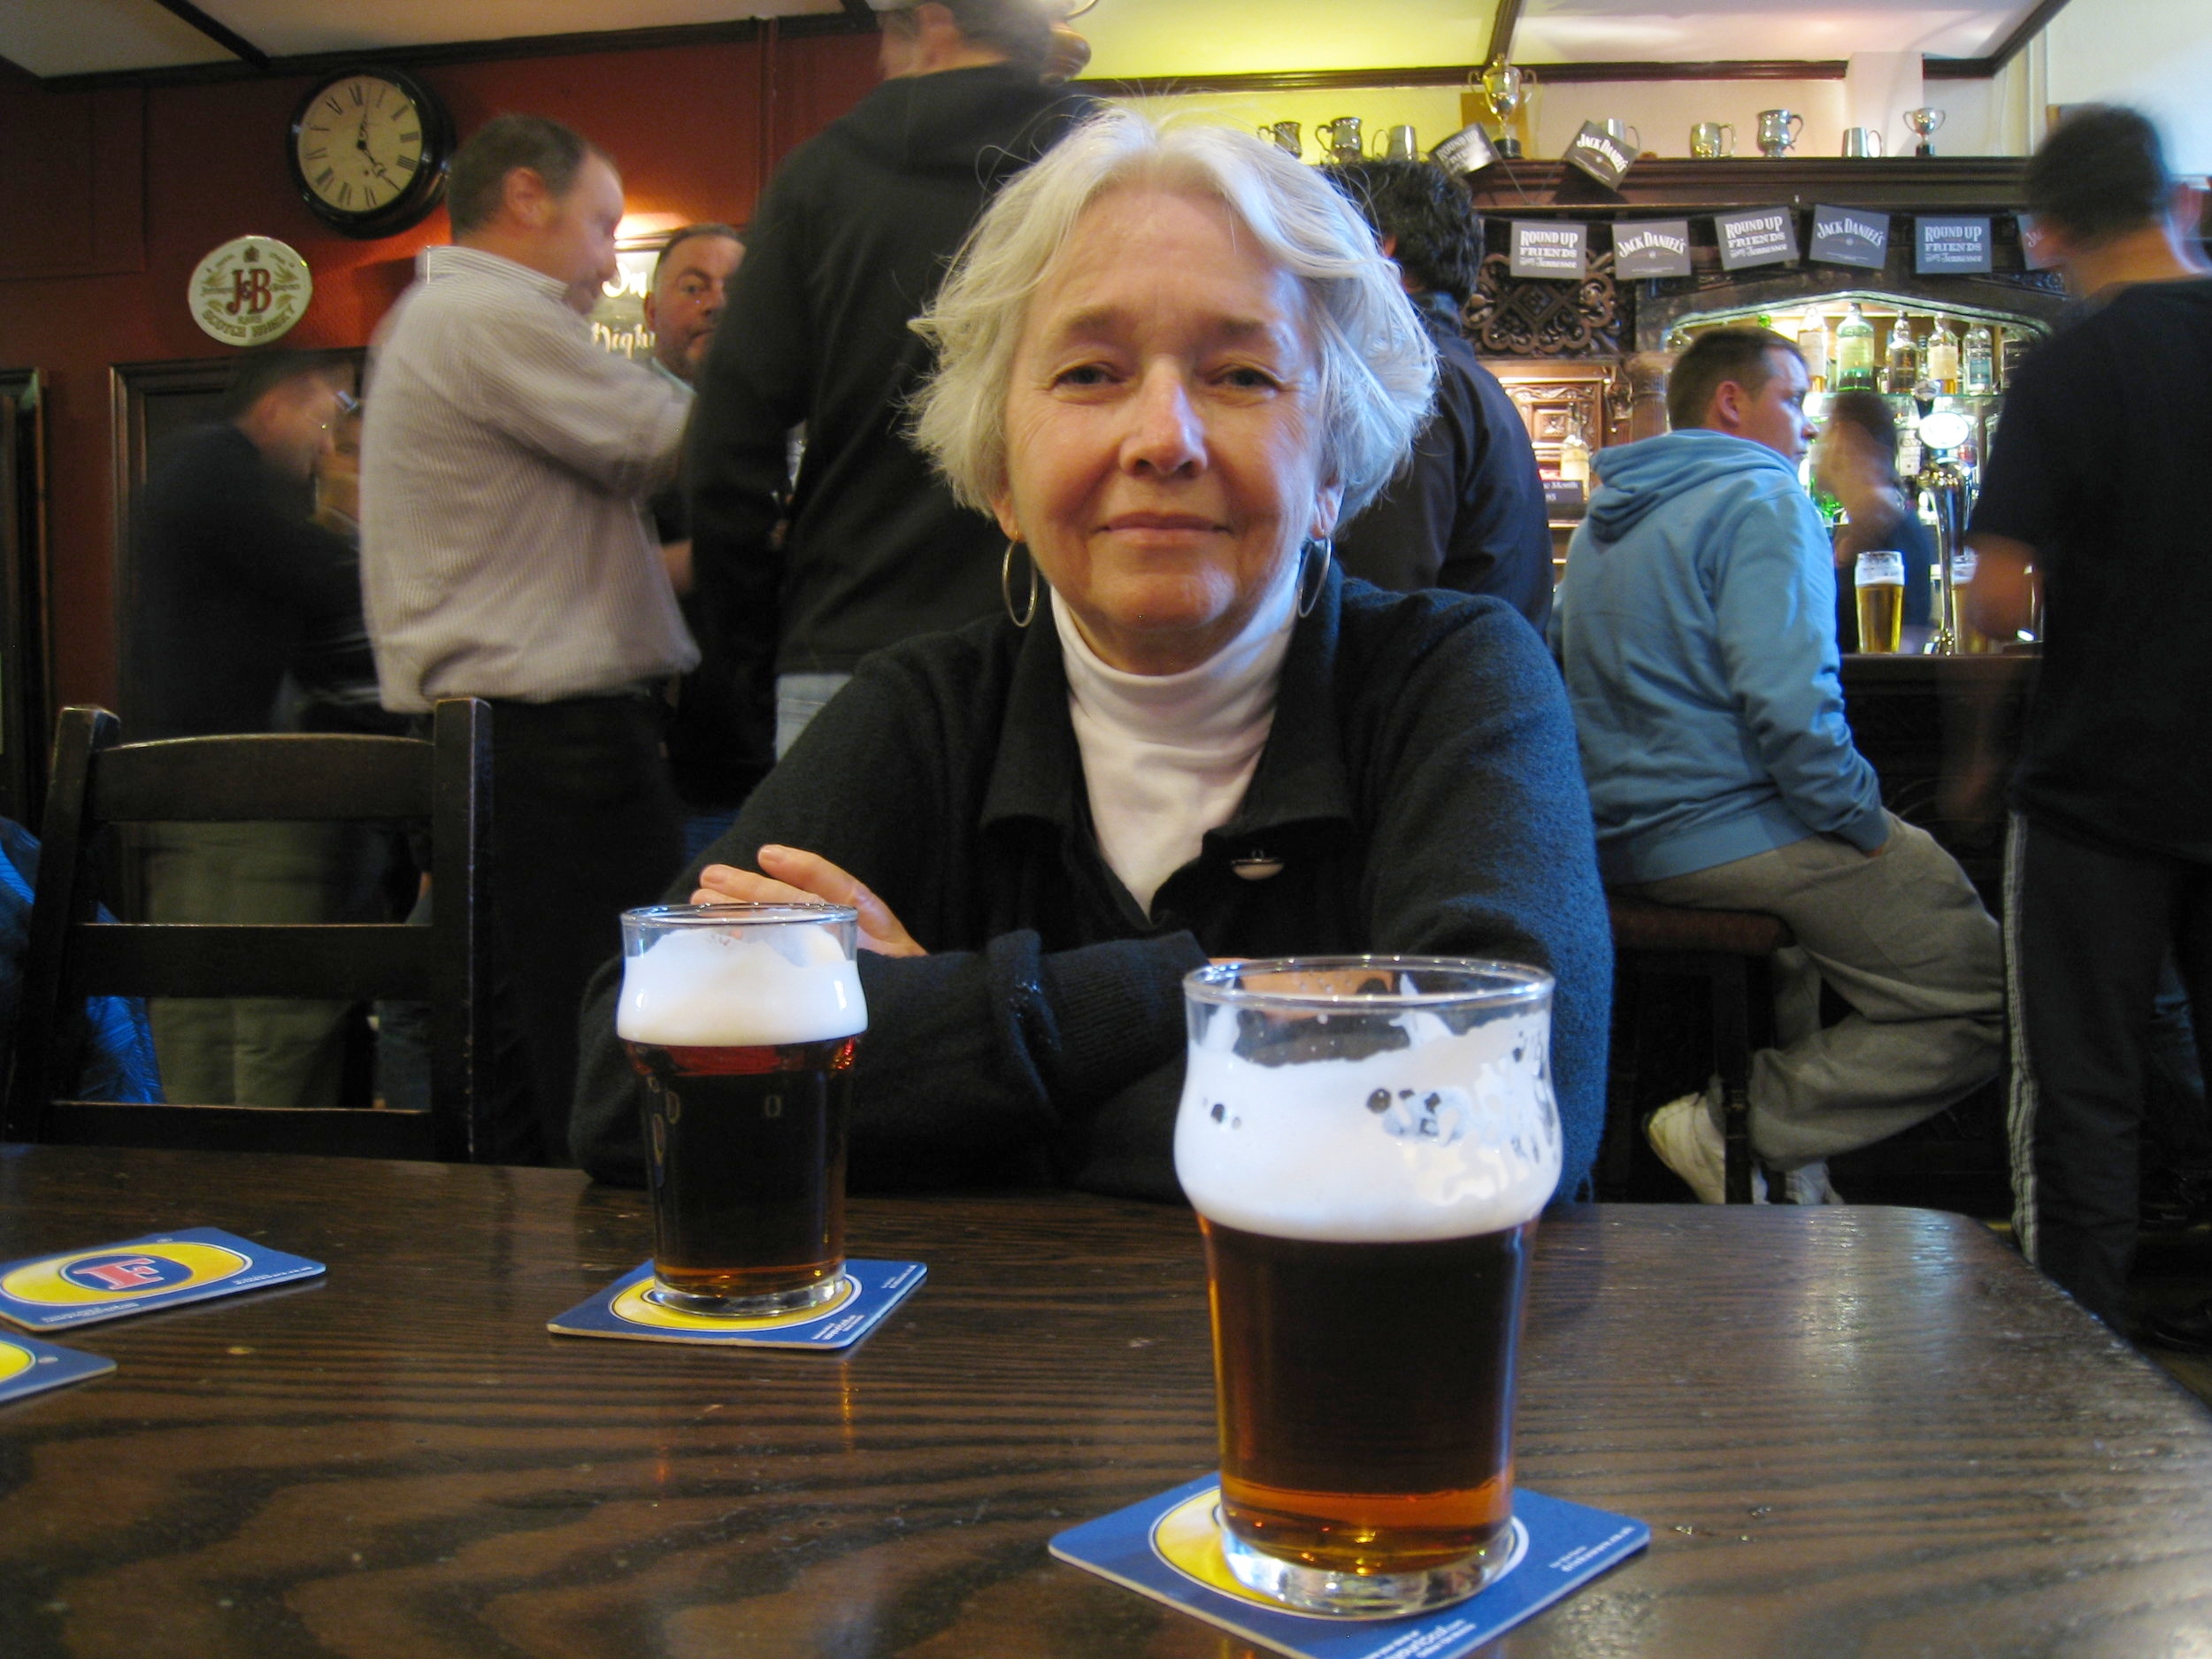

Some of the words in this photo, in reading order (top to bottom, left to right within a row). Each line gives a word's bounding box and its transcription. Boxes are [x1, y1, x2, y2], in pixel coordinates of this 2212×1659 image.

[1577, 133, 1602, 153] JACK
[1724, 219, 1765, 240] ROUND
[1764, 216, 1784, 232] UP
[1817, 220, 1845, 240] JACK
[1844, 218, 1885, 248] DANIEL'S
[1924, 226, 1963, 242] ROUND
[1964, 226, 1982, 242] UP
[1520, 230, 1559, 247] ROUND
[1560, 232, 1578, 249] UP
[1617, 235, 1644, 258] JACK
[1642, 231, 1687, 256] DANIEL'S
[1727, 231, 1786, 249] FRIENDS
[1924, 242, 1982, 252] FRIENDS
[1519, 247, 1578, 258] FRIENDS
